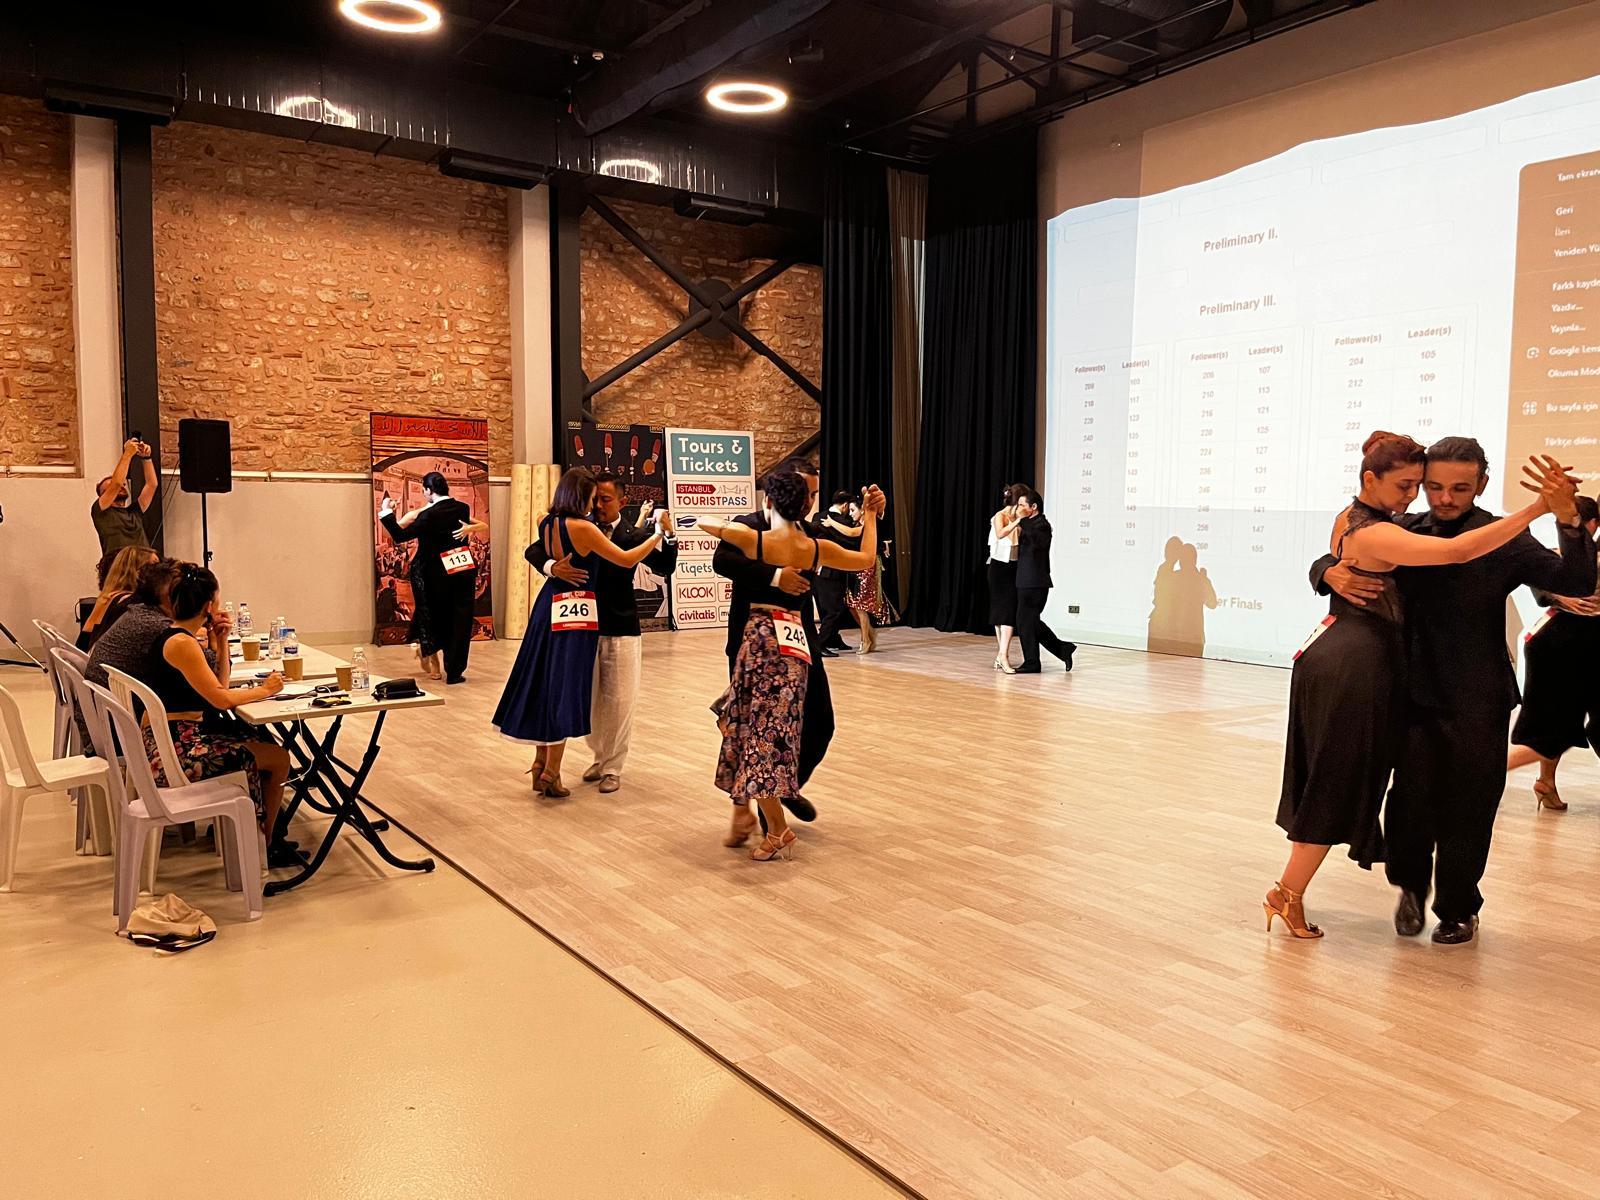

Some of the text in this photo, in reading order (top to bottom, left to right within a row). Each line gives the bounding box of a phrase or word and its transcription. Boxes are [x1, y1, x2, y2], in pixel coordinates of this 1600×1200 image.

[1557, 173, 1574, 182] Tam
[1555, 206, 1574, 216] Geri
[1203, 227, 1278, 252] Preliminary II.
[1553, 247, 1587, 257] Yeniden
[1200, 294, 1276, 316] Preliminary III.
[1334, 326, 1452, 346] Follower(s) Leader(s)
[1248, 345, 1283, 355] Leader(s)
[1549, 346, 1580, 357] Google
[1348, 350, 1437, 366] 204 105
[1259, 366, 1271, 374] 107
[1347, 373, 1436, 388] 212 109
[1202, 391, 1214, 399] 210
[1346, 396, 1433, 410] 214 111
[1546, 403, 1558, 412] Bu
[1345, 418, 1433, 430] 222 119
[678, 437, 744, 455] Tours &
[1256, 446, 1268, 455] 127
[678, 456, 739, 473] Tickets
[677, 485, 712, 493] ISTANBUL
[676, 496, 748, 506] TOURISTPASS
[1252, 525, 1265, 533] 147
[678, 540, 694, 550] GET
[449, 554, 468, 565] 113
[678, 562, 713, 577] Tiqets
[679, 586, 714, 599] KLOOK
[1230, 596, 1263, 609] Finals
[559, 603, 589, 617] 246
[679, 609, 716, 621] civitatis
